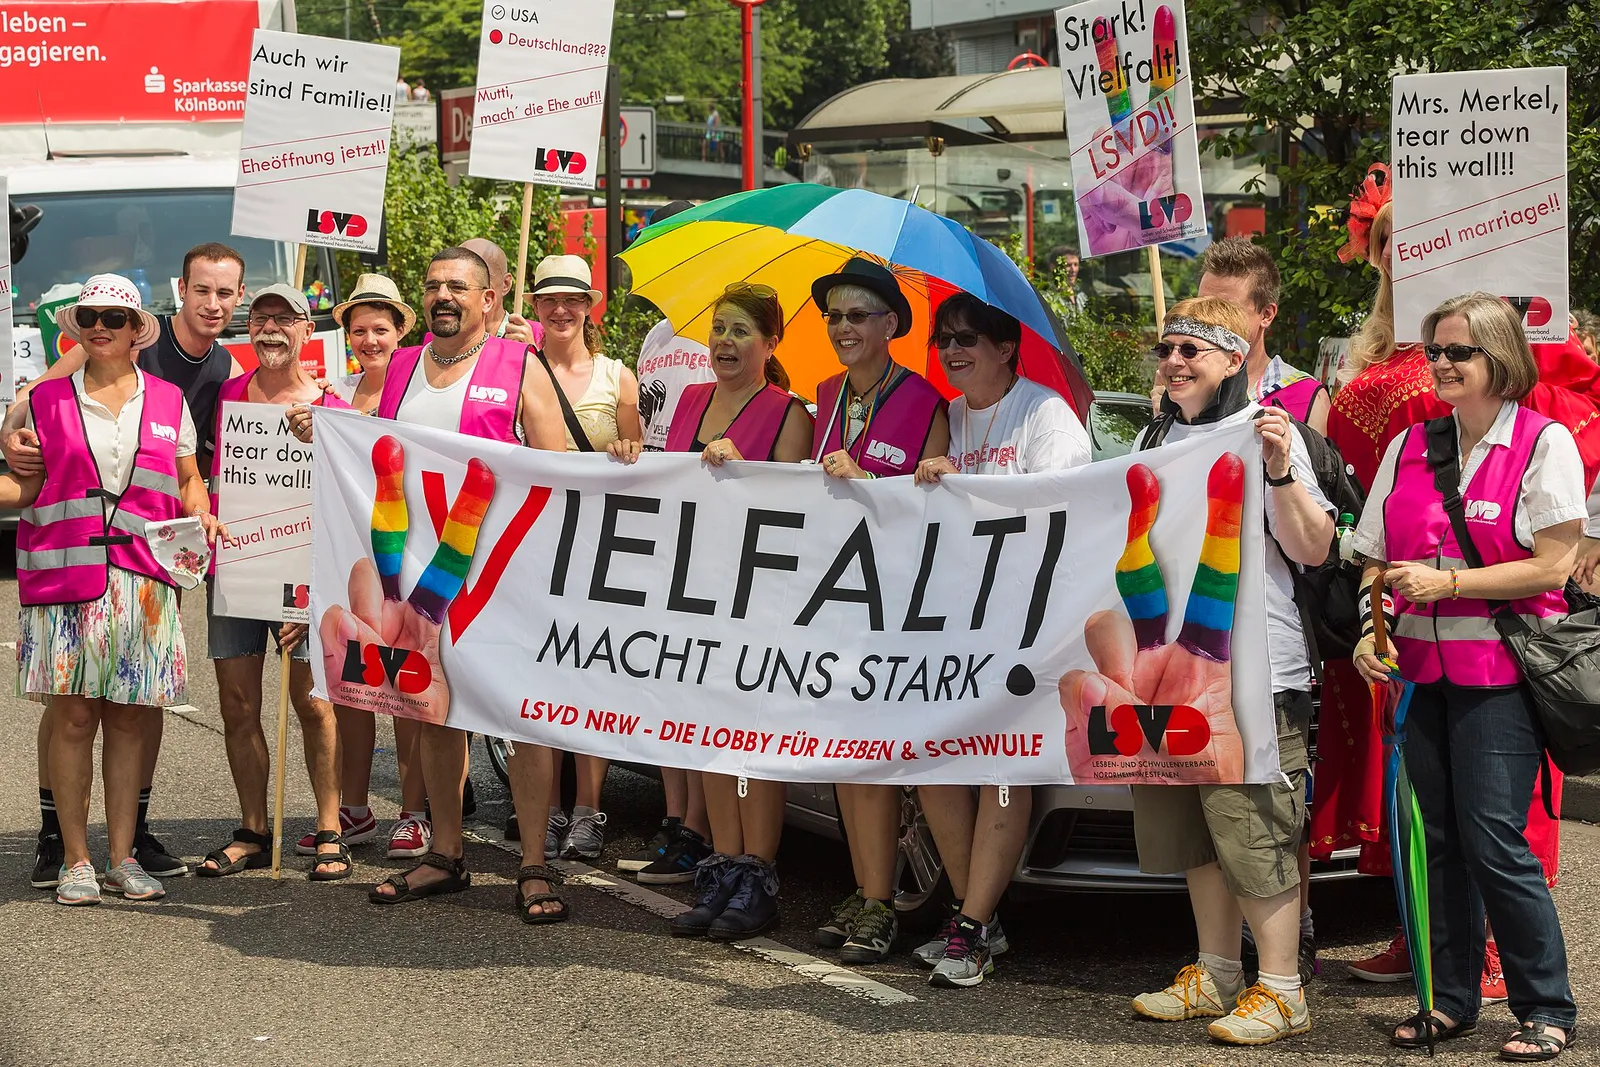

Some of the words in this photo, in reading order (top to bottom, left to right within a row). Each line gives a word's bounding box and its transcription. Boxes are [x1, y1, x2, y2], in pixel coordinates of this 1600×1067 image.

[1, 11, 66, 33] leben
[510, 8, 539, 24] USA
[1064, 0, 1147, 51] Stark!
[253, 44, 306, 68] Auch
[316, 55, 349, 73] wir
[508, 33, 607, 58] Deutschland???
[1067, 40, 1182, 100] Vielfalt!
[173, 78, 247, 96] Sparkasse
[250, 78, 293, 100] sind
[301, 84, 392, 113] Familie!!
[477, 86, 514, 103] Mutti,
[1397, 91, 1449, 116] Mrs.
[1459, 85, 1559, 115] Merkel,
[175, 97, 245, 113] KölnBonn
[524, 103, 544, 117] die
[547, 98, 570, 112] Ehe
[574, 90, 603, 106] auf!!
[1087, 95, 1177, 181] LSVD!!
[1397, 127, 1450, 147] tear
[1460, 120, 1530, 145] down
[241, 150, 335, 174] Eheöffnung
[340, 139, 387, 164] jetzt!!
[535, 147, 587, 175] LSVD
[1397, 155, 1438, 179] this
[1447, 151, 1515, 177] wall!!
[306, 208, 368, 238] LSVD
[1138, 193, 1193, 230] LSVD
[1396, 227, 1452, 262] Equal
[1457, 192, 1562, 243] marriage!!
[468, 385, 508, 403] LSVD
[225, 413, 269, 436] Mrs.
[224, 442, 268, 461] tear
[276, 443, 313, 463] dow
[866, 439, 907, 465] LSVD
[223, 464, 257, 485] this
[265, 469, 312, 490] wall!
[270, 516, 312, 539] marri
[282, 583, 310, 610] LS
[341, 639, 433, 695] LSVD
[535, 618, 722, 685] MACHT
[735, 644, 840, 699] UNS
[850, 652, 996, 702] STARK
[364, 690, 377, 698] UND
[520, 698, 579, 726] LSVD
[584, 710, 641, 736] NRW
[659, 720, 697, 745] DIE
[700, 725, 774, 755] LOBBY
[777, 730, 819, 758] FÜR
[822, 737, 895, 761] LESBEN
[900, 740, 919, 761] &
[926, 733, 1044, 759] SCHWULE
[1088, 703, 1211, 757] LSVD
